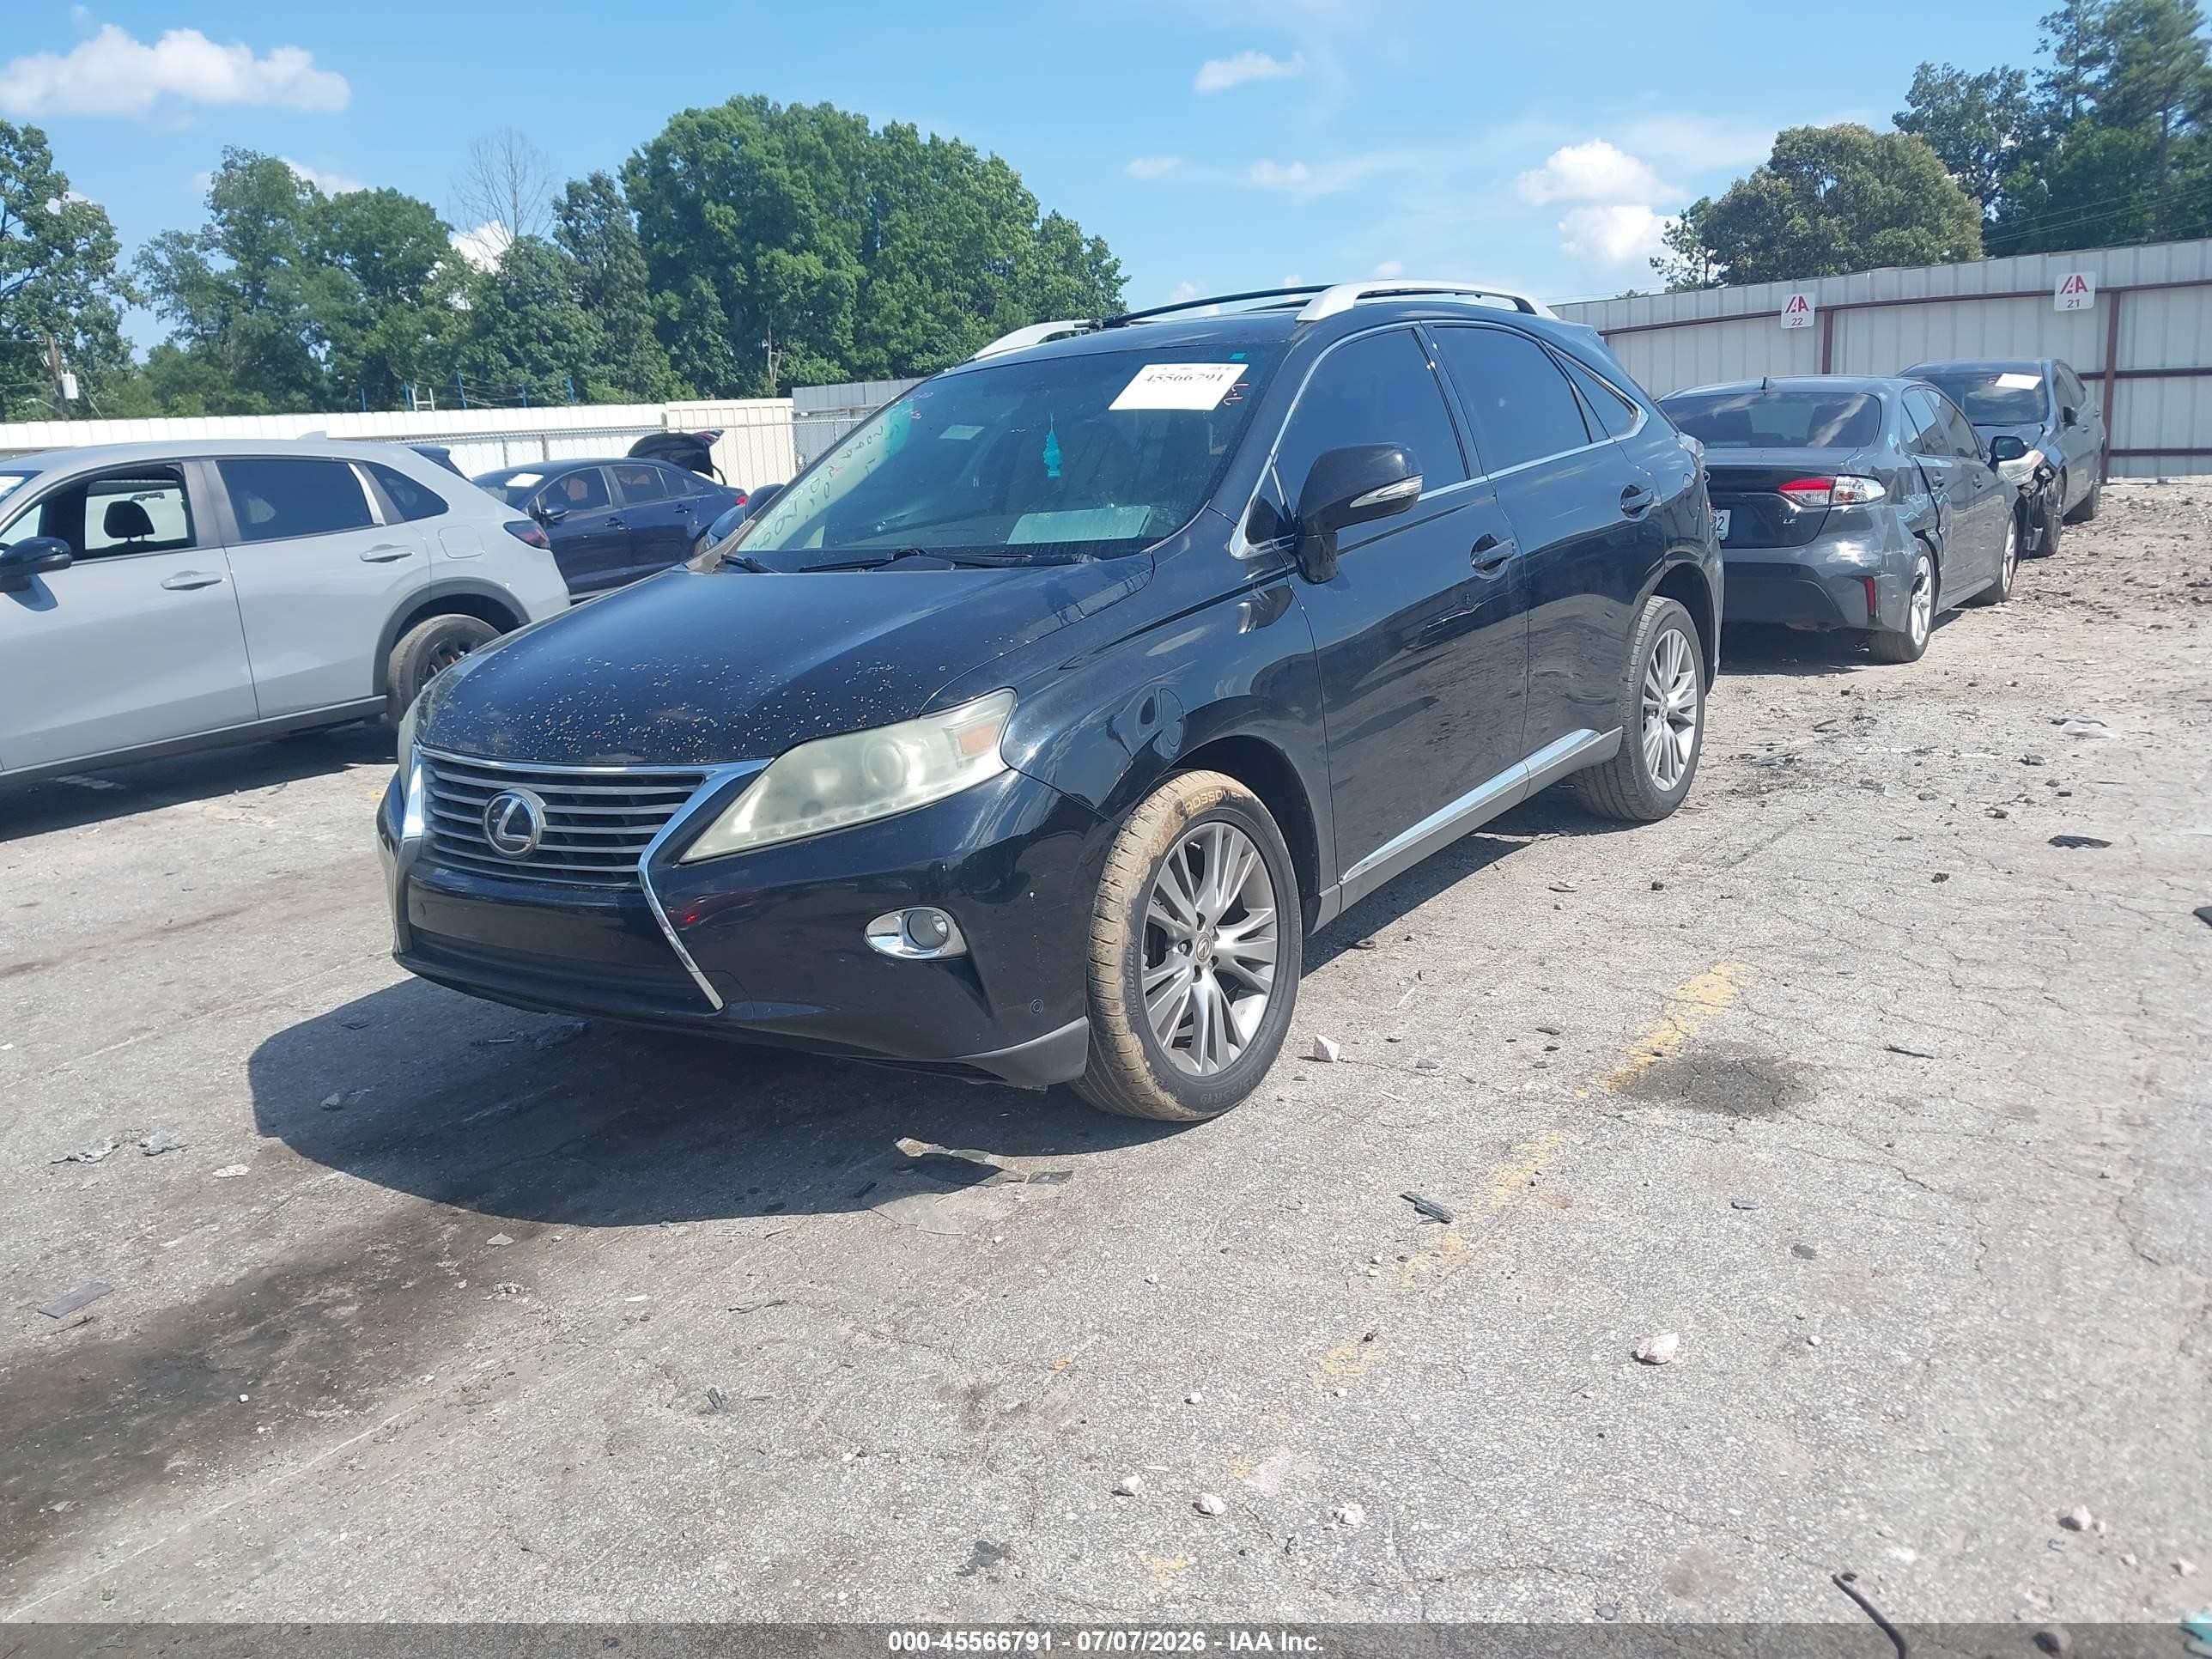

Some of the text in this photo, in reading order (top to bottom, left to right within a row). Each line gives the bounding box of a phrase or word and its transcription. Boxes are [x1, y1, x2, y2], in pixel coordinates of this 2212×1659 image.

[2067, 299, 2081, 308] 21
[1791, 317, 1804, 326] 22
[1181, 789, 1245, 815] ROSSOVER
